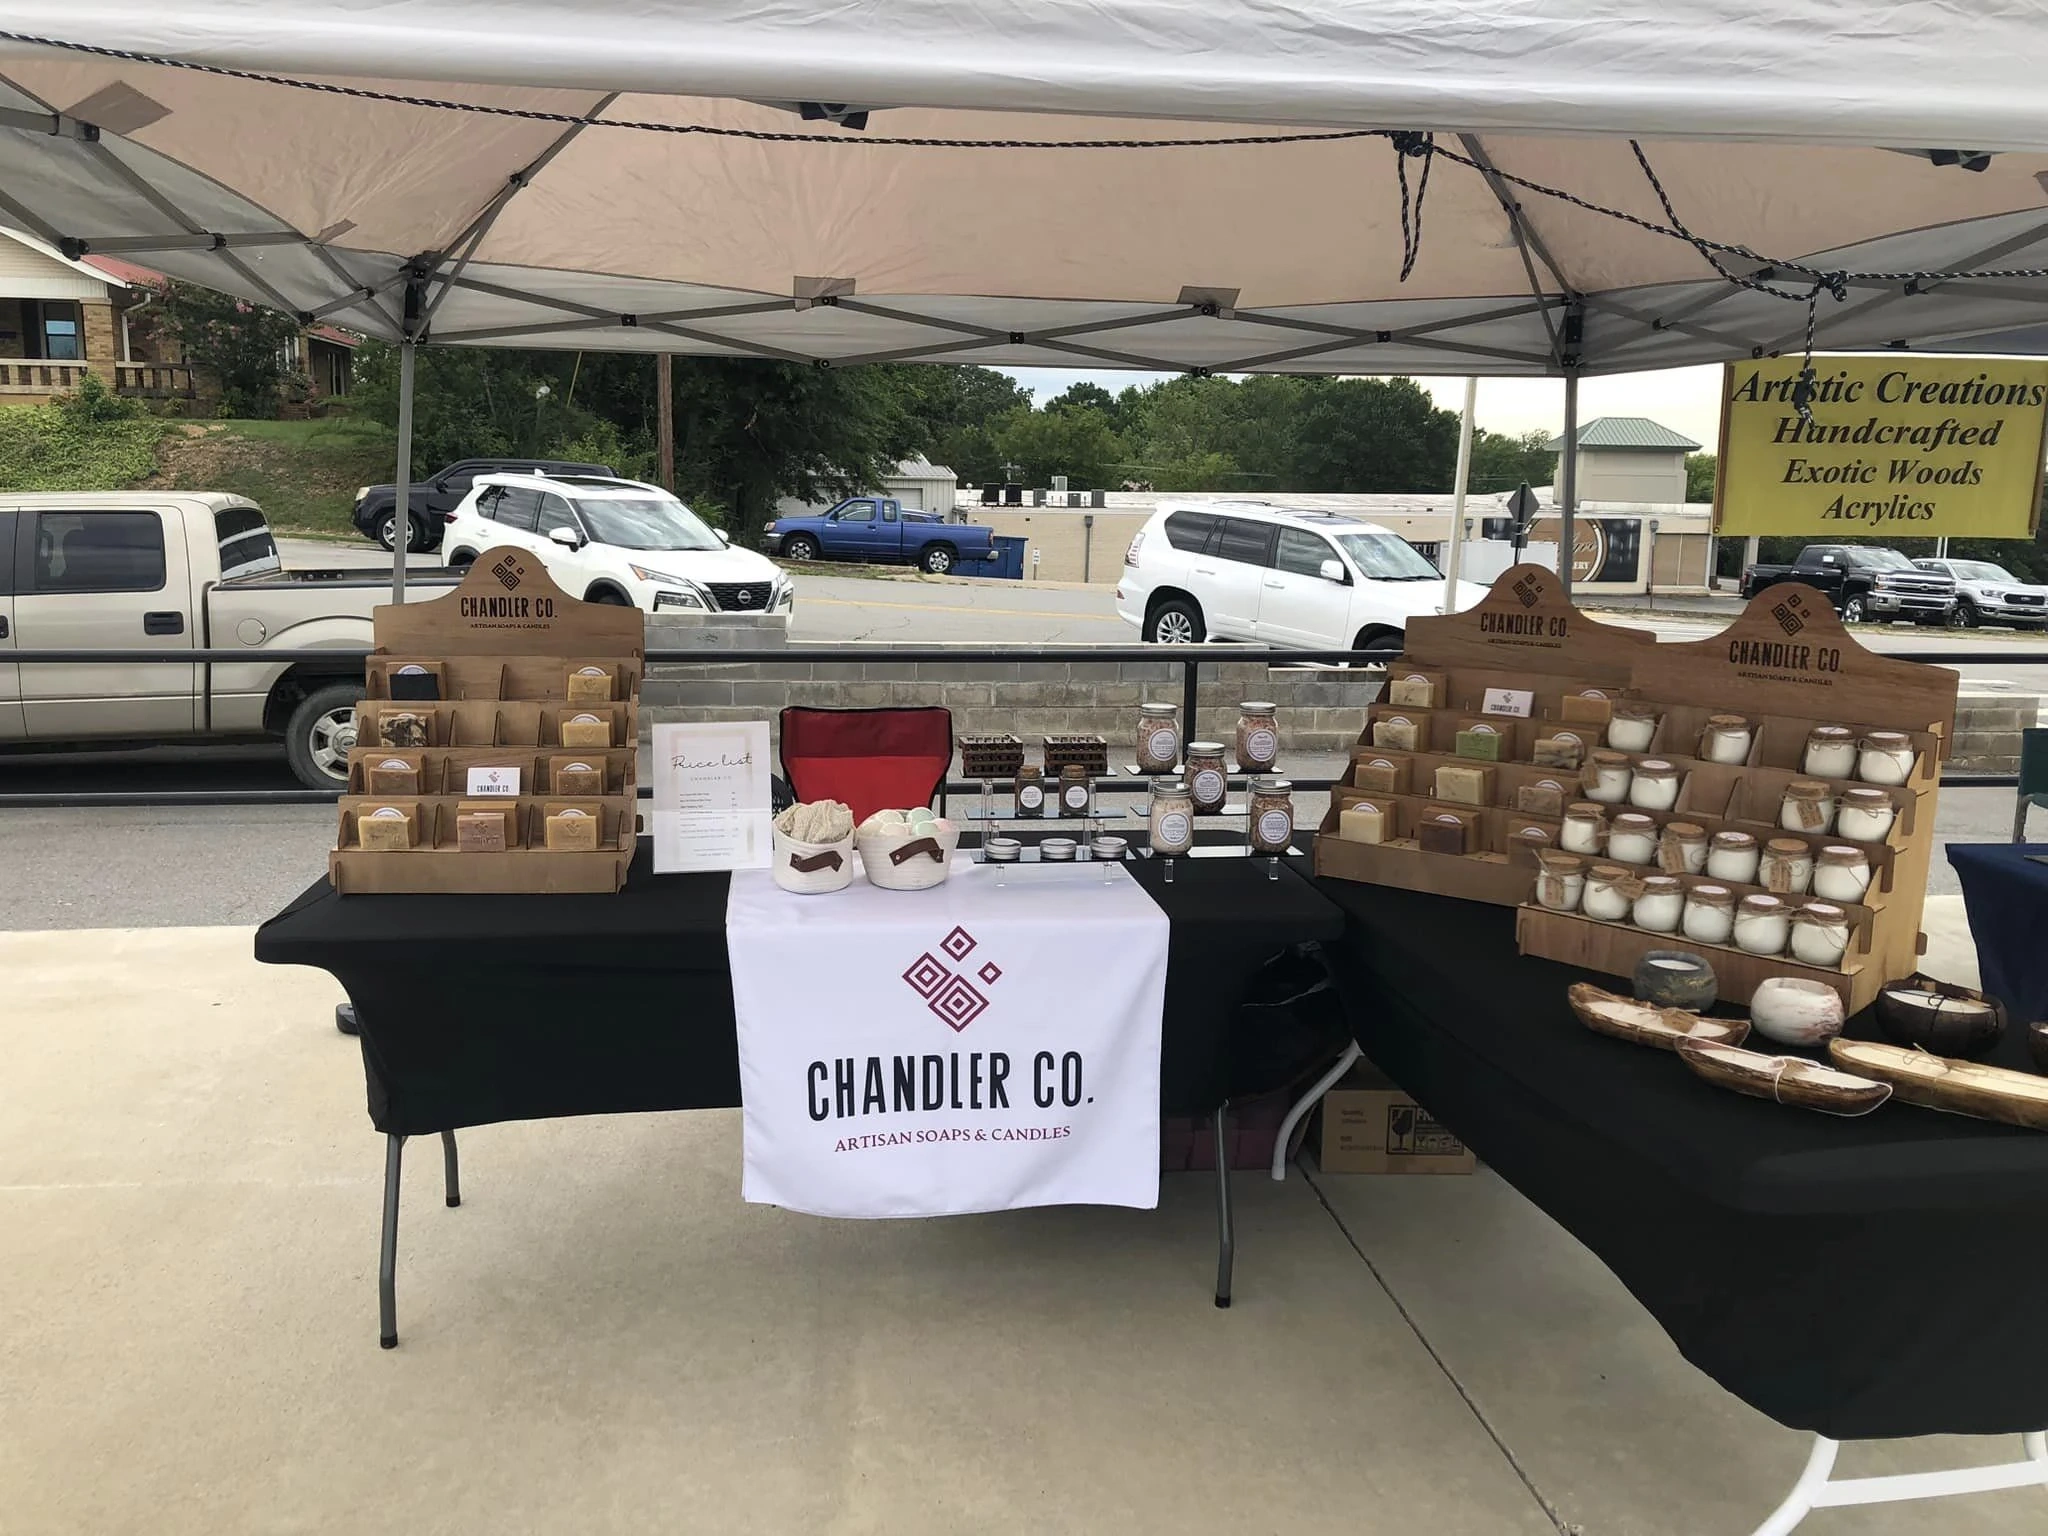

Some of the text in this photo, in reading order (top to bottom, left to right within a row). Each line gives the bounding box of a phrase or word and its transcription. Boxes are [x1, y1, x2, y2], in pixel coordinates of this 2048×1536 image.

[1877, 371, 2046, 406] Creations
[1771, 416, 2003, 452] Handcrafted
[1782, 458, 1983, 485] Exotic Woods
[1821, 494, 1935, 526] Acrylics
[461, 597, 558, 618] CHANDLER CO.
[1480, 612, 1570, 638] CHANDLER CO.
[1729, 640, 1844, 674] CHANDLER CO.
[672, 752, 753, 770] Price list
[807, 1050, 1094, 1121] CHANDLER CO.
[834, 1125, 1071, 1152] ARTISAN SOAPS & CANDLES
